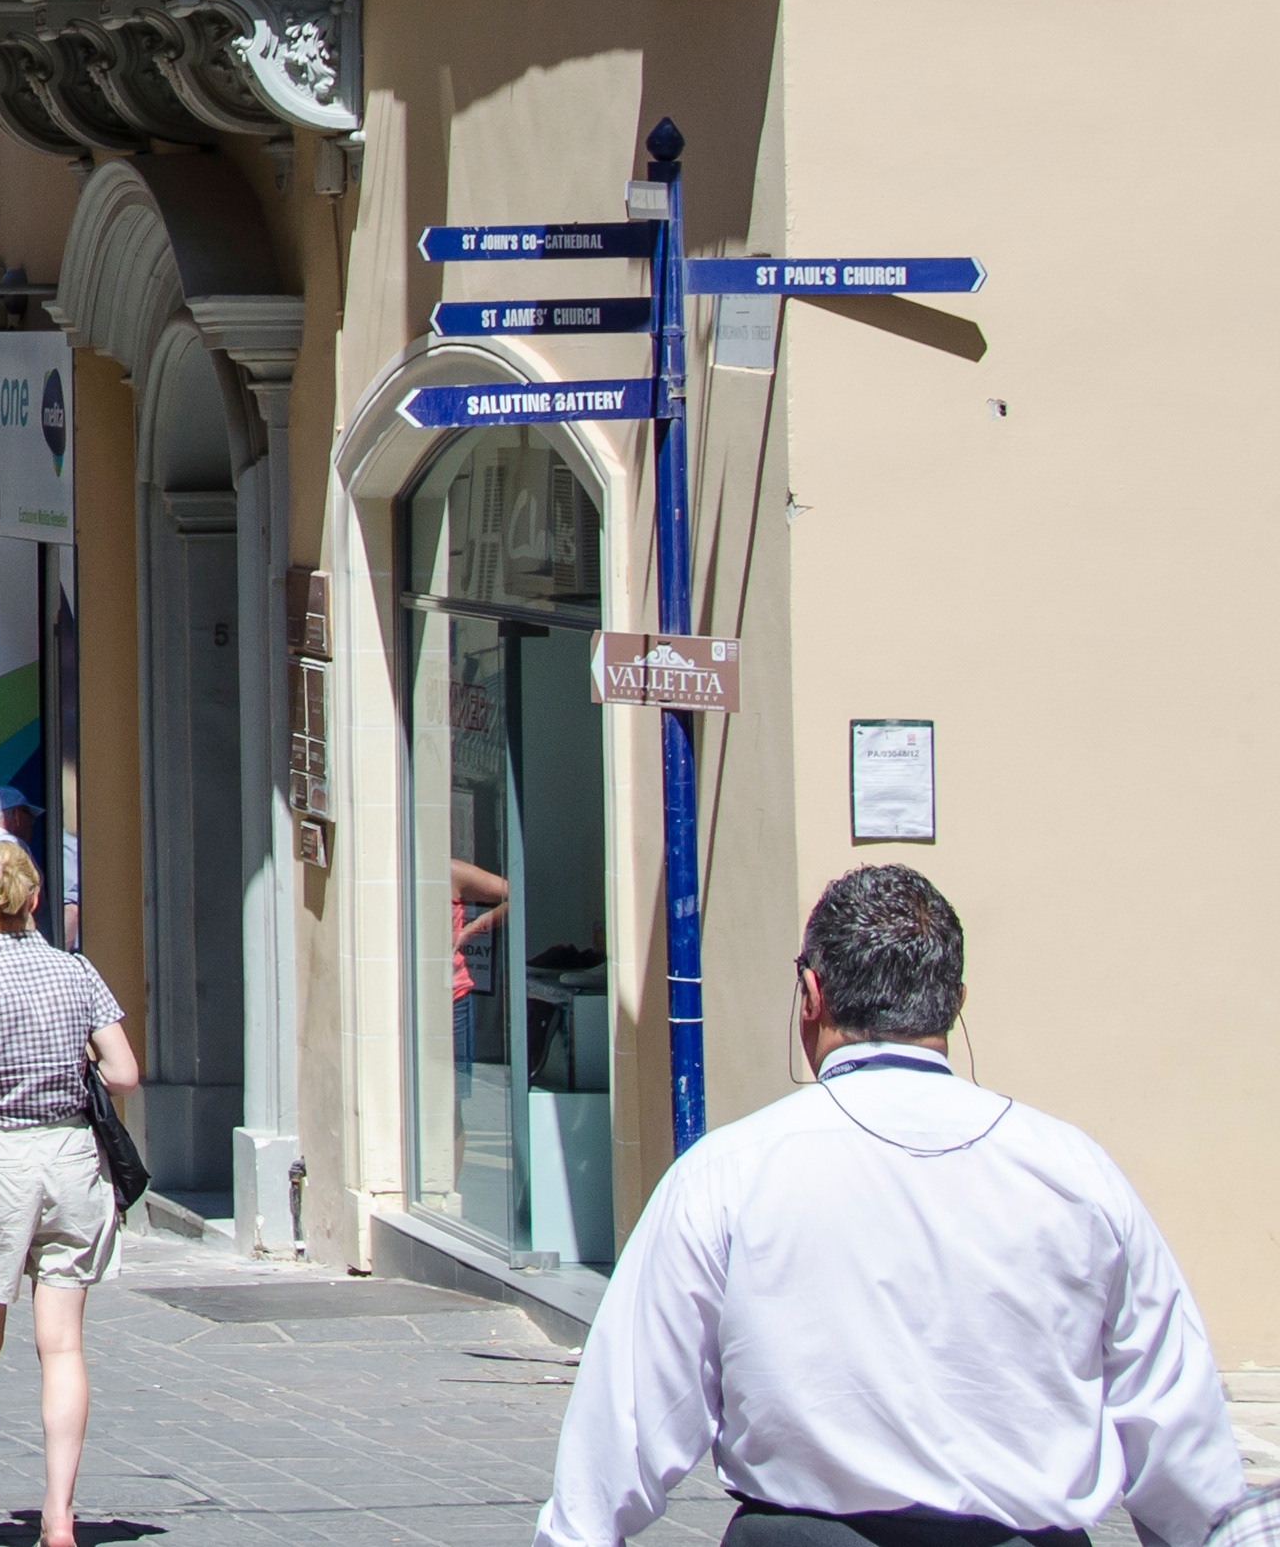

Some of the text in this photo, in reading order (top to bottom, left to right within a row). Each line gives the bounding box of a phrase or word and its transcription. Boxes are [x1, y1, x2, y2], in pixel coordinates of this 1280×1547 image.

[461, 233, 603, 250] ST JOHN'S CO-CATHEDRAL
[756, 266, 907, 286] ST PAUL'S CHURCH
[481, 307, 601, 328] ST JAMES' CHURCH
[466, 390, 624, 415] SALUTING BATTERY
[214, 622, 229, 647] 5
[606, 665, 725, 695] VALLETTA
[663, 691, 719, 703] HISTORY
